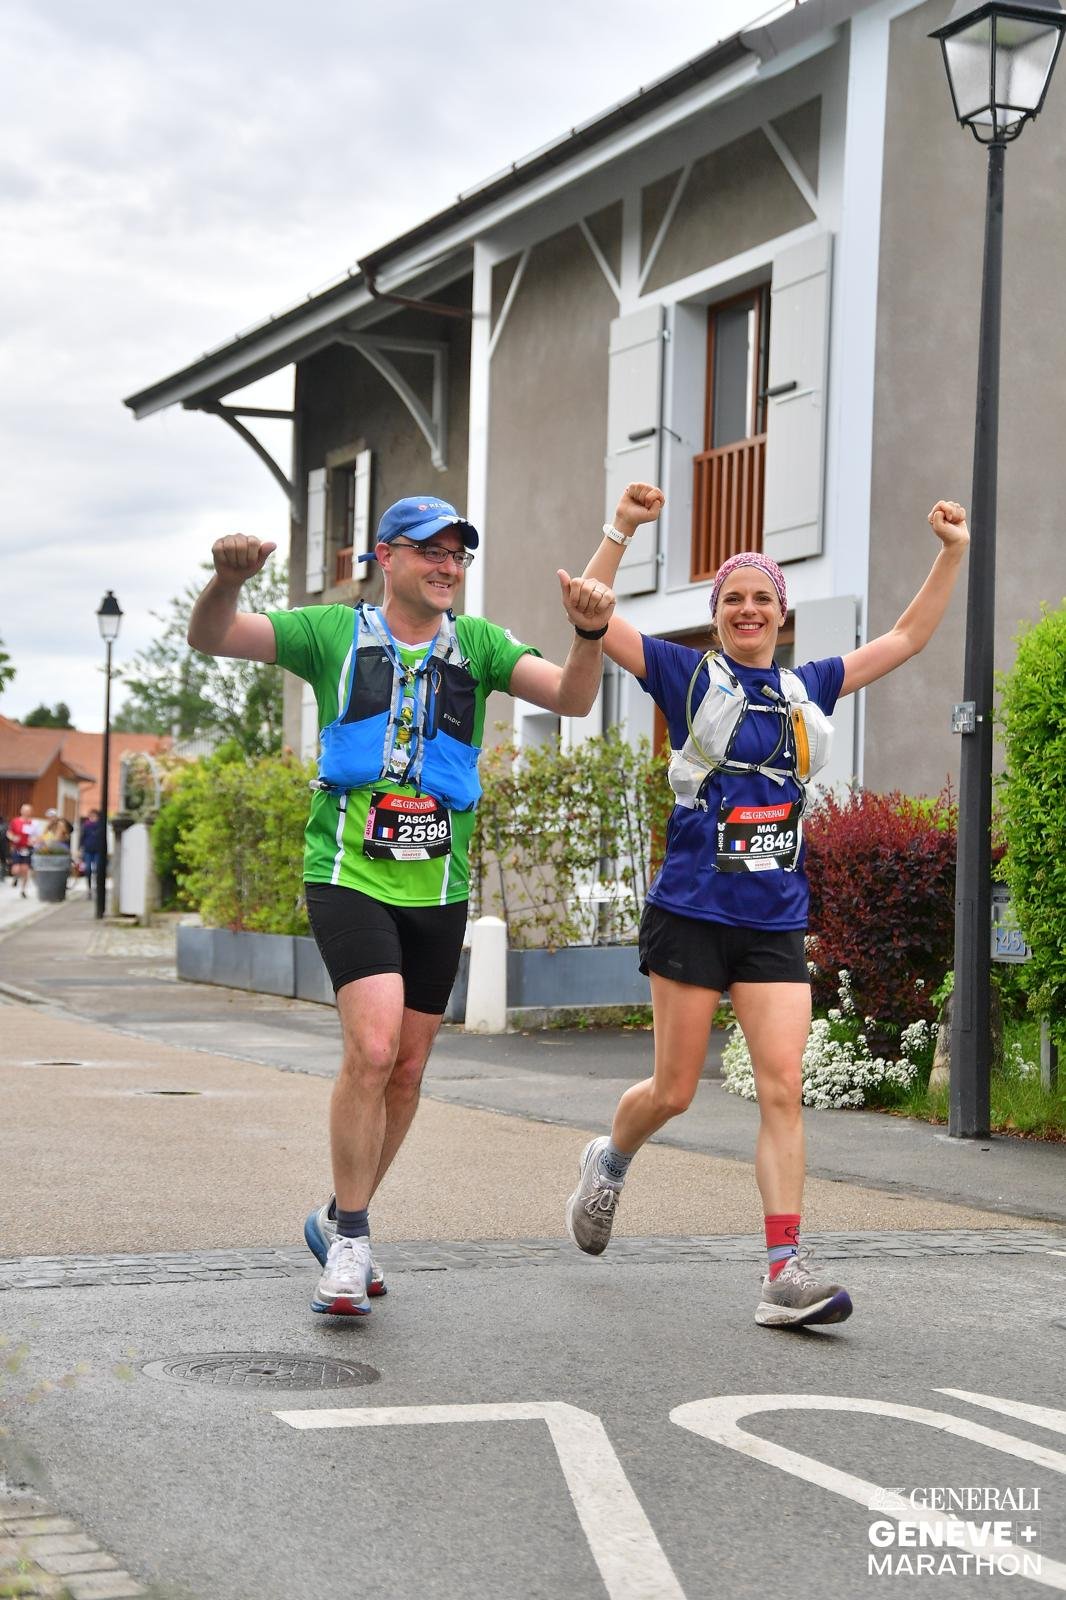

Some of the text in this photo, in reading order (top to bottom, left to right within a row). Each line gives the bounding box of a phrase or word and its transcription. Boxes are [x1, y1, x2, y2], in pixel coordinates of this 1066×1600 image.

[397, 814, 436, 823] PASCAL
[397, 820, 448, 842] 2598
[757, 824, 778, 833] MAG
[750, 831, 793, 853] 2842
